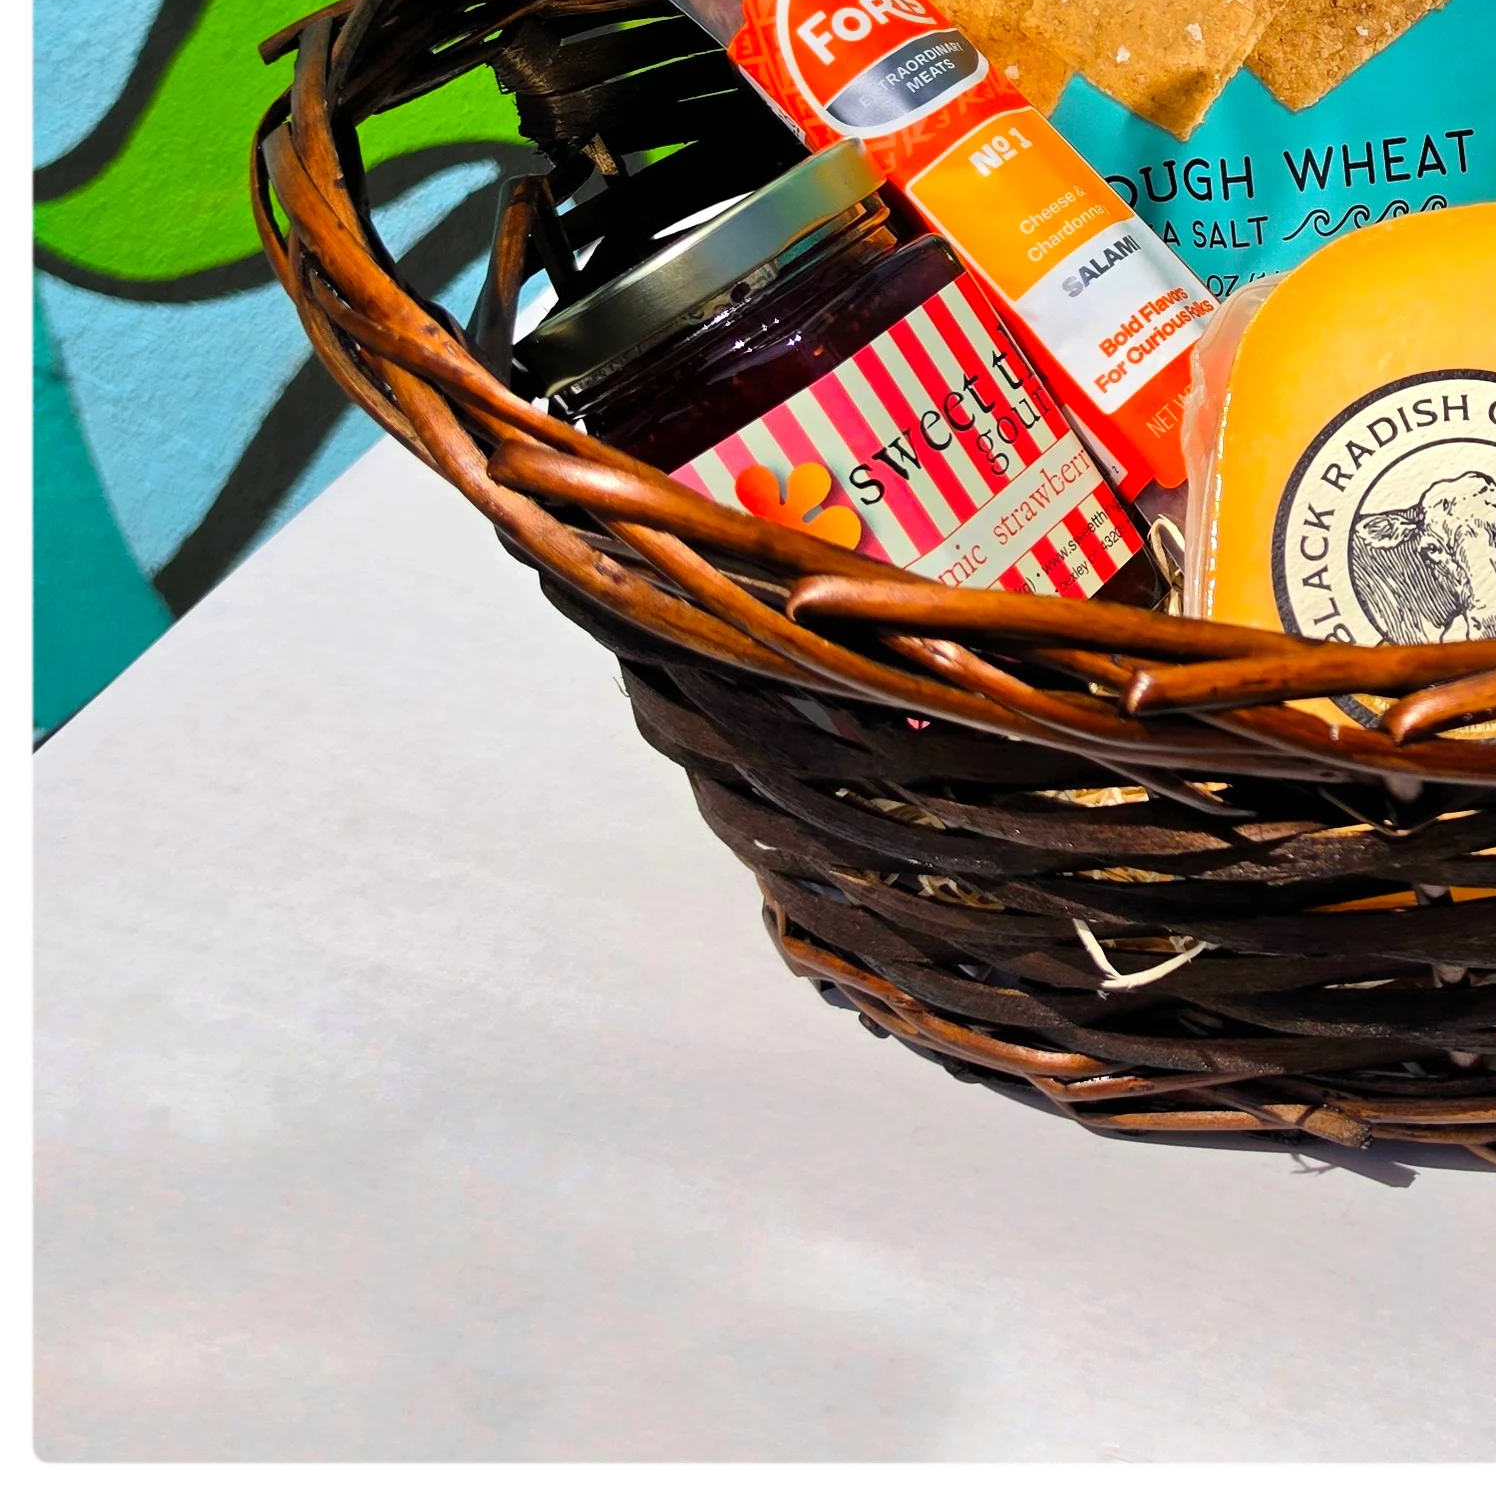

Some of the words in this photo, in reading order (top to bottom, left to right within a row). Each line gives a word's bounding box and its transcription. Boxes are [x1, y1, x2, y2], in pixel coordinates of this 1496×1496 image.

[905, 57, 956, 94] MEATS
[1015, 126, 1034, 152] 1
[1282, 127, 1477, 194] WHEAT
[1018, 190, 1077, 237] Cheese
[1074, 184, 1088, 199] &
[1192, 215, 1270, 250] SALT
[1061, 234, 1142, 298] SALAMI
[1093, 363, 1128, 395] For
[1125, 308, 1192, 366] Curious
[1184, 298, 1216, 322] Folks
[1098, 315, 1144, 359] Bold
[1142, 286, 1190, 324] Flavors
[848, 372, 997, 507] sweet
[1145, 402, 1180, 440] NET
[1320, 393, 1471, 493] RADISH
[1300, 501, 1356, 646] BLACK
